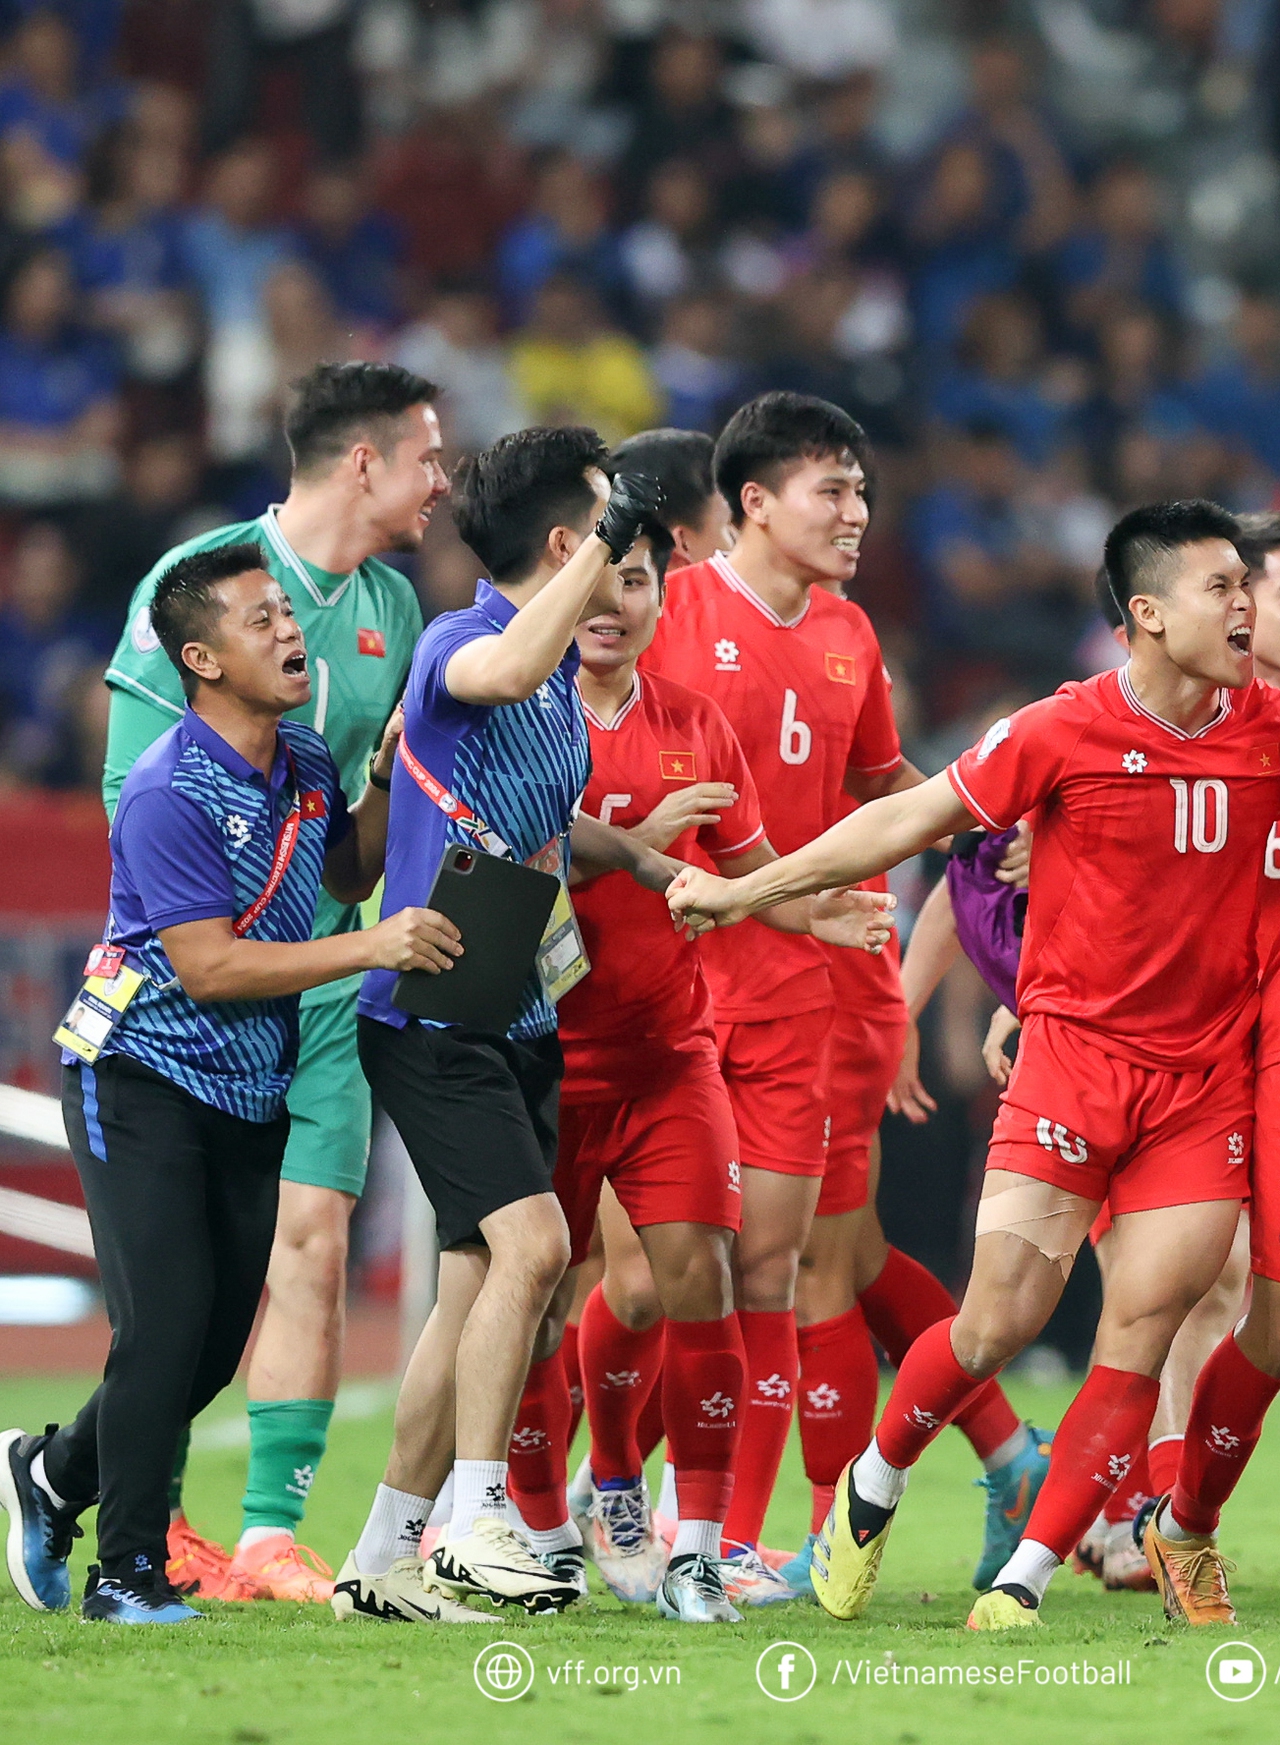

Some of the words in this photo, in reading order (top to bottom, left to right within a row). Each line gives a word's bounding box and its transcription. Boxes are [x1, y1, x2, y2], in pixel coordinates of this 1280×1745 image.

[779, 688, 812, 765] 6
[1169, 777, 1228, 853] 10
[253, 897, 267, 914] CUP
[265, 861, 284, 898] ELECTRIC
